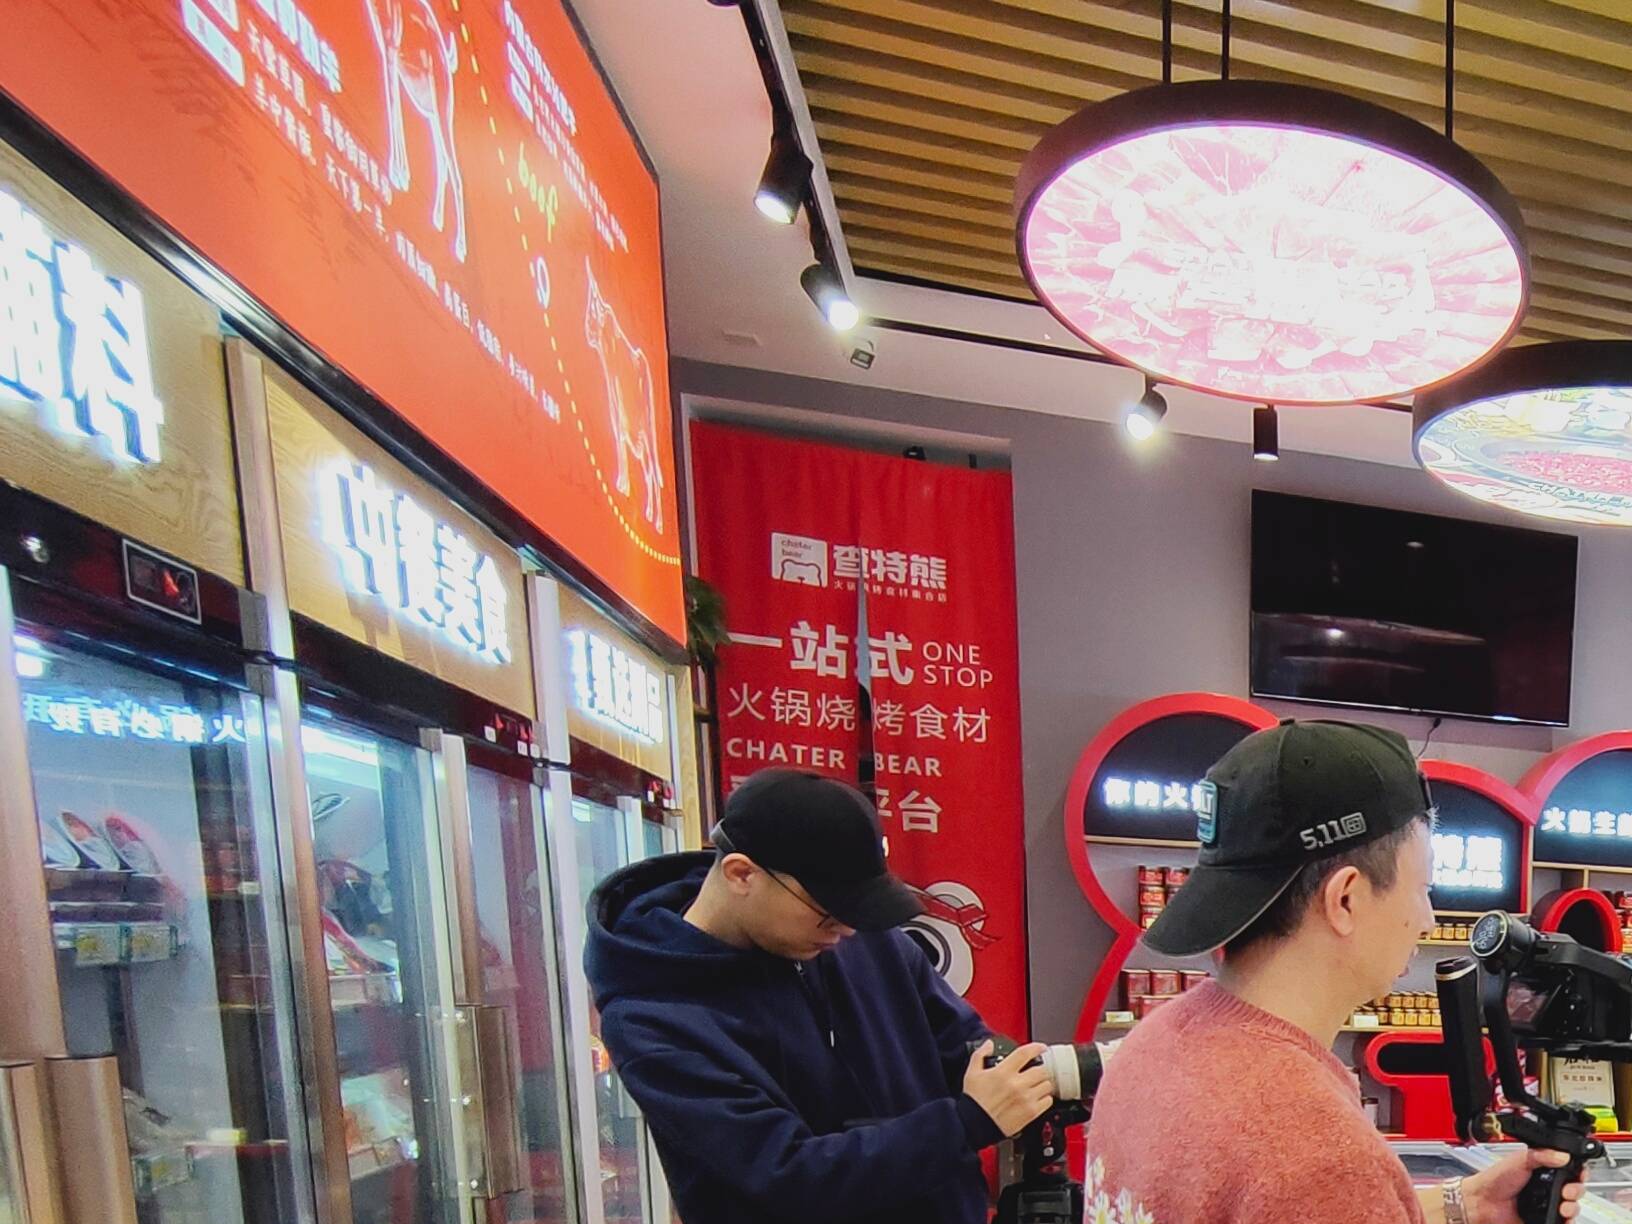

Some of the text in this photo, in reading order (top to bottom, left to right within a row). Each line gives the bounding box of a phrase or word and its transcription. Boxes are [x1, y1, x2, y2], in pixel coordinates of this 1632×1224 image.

[832, 544, 948, 590] 查特熊
[728, 621, 914, 686] 一站式
[922, 641, 981, 665] ONE
[922, 665, 994, 689] STOP
[727, 683, 991, 743] 火锅烧烤食材
[727, 737, 942, 778] CHATER BEAR
